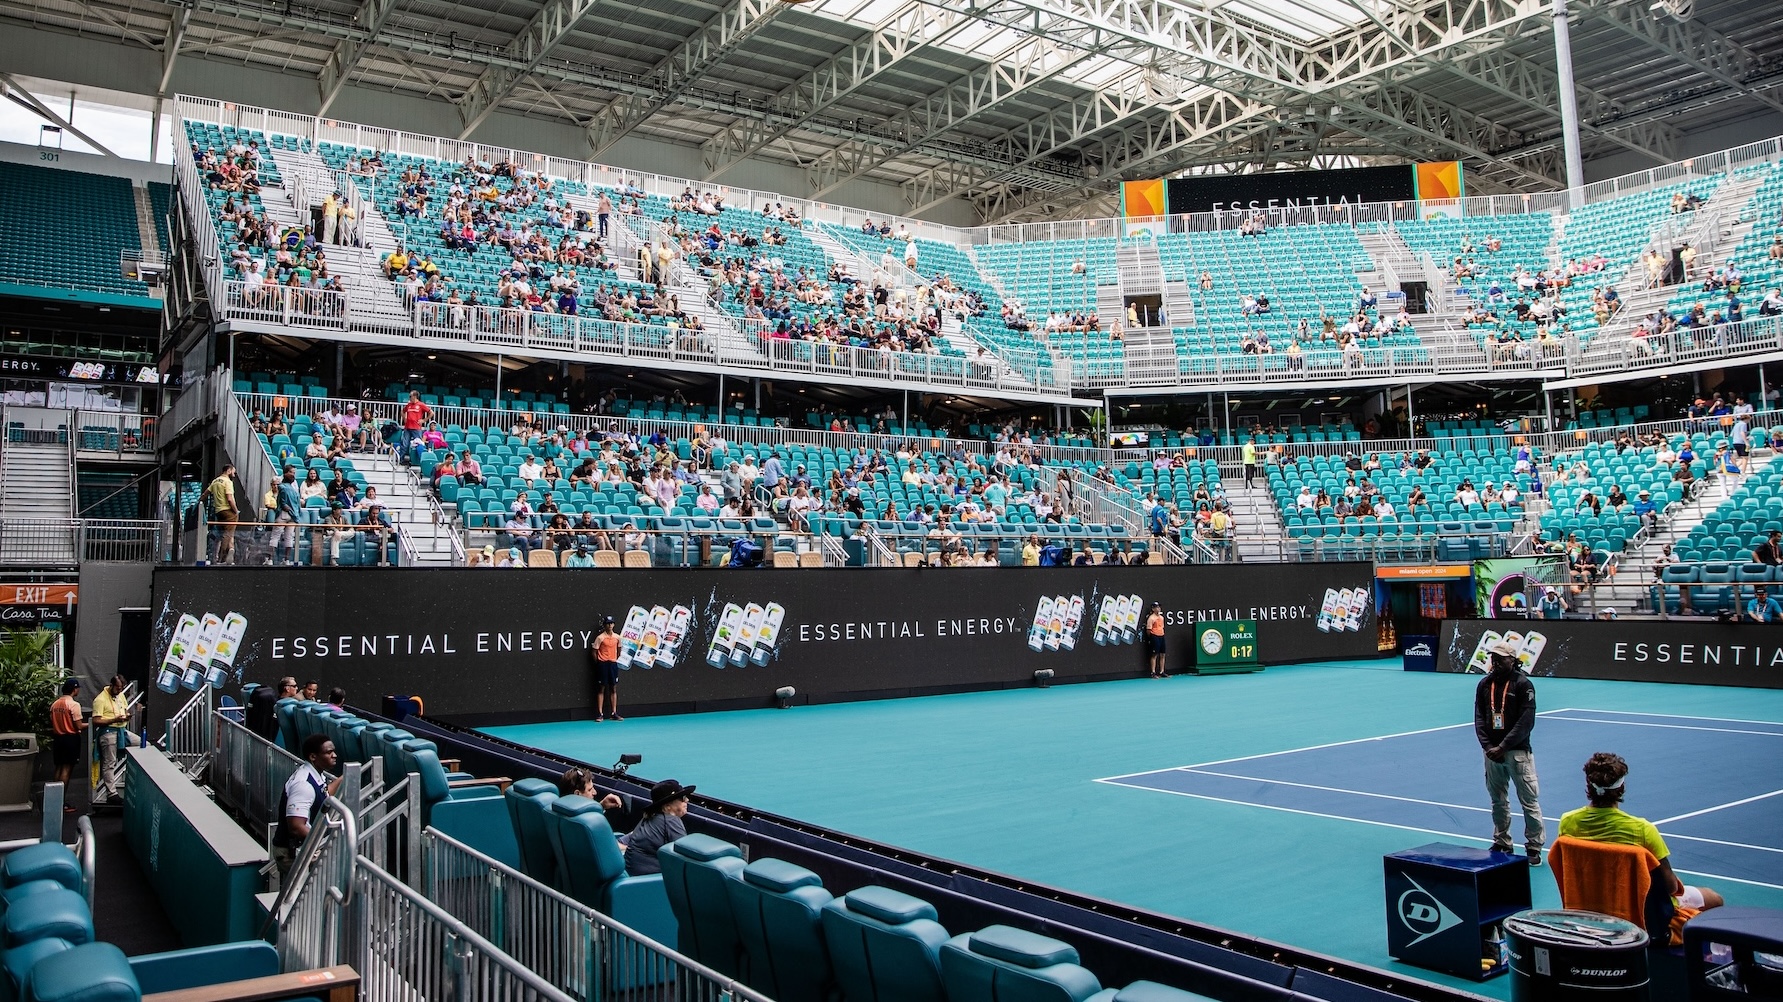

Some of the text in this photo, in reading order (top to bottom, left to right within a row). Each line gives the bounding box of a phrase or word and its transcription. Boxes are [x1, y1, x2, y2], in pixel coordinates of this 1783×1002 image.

[40, 152, 59, 162] 301
[1212, 194, 1369, 218] ESSENTIAL
[15, 586, 49, 603] EXIT
[1, 606, 62, 620] Casa Tua
[1250, 605, 1306, 621] ENERGY
[799, 620, 925, 642] ESSENTIAL
[937, 617, 1015, 636] ENERGY
[1230, 632, 1254, 640] ROLEX
[272, 630, 591, 659] ESSENTIAL ENERGY
[1231, 645, 1253, 658] 0:17
[1406, 902, 1439, 923] D
[1580, 968, 1627, 977] DUNLOP
